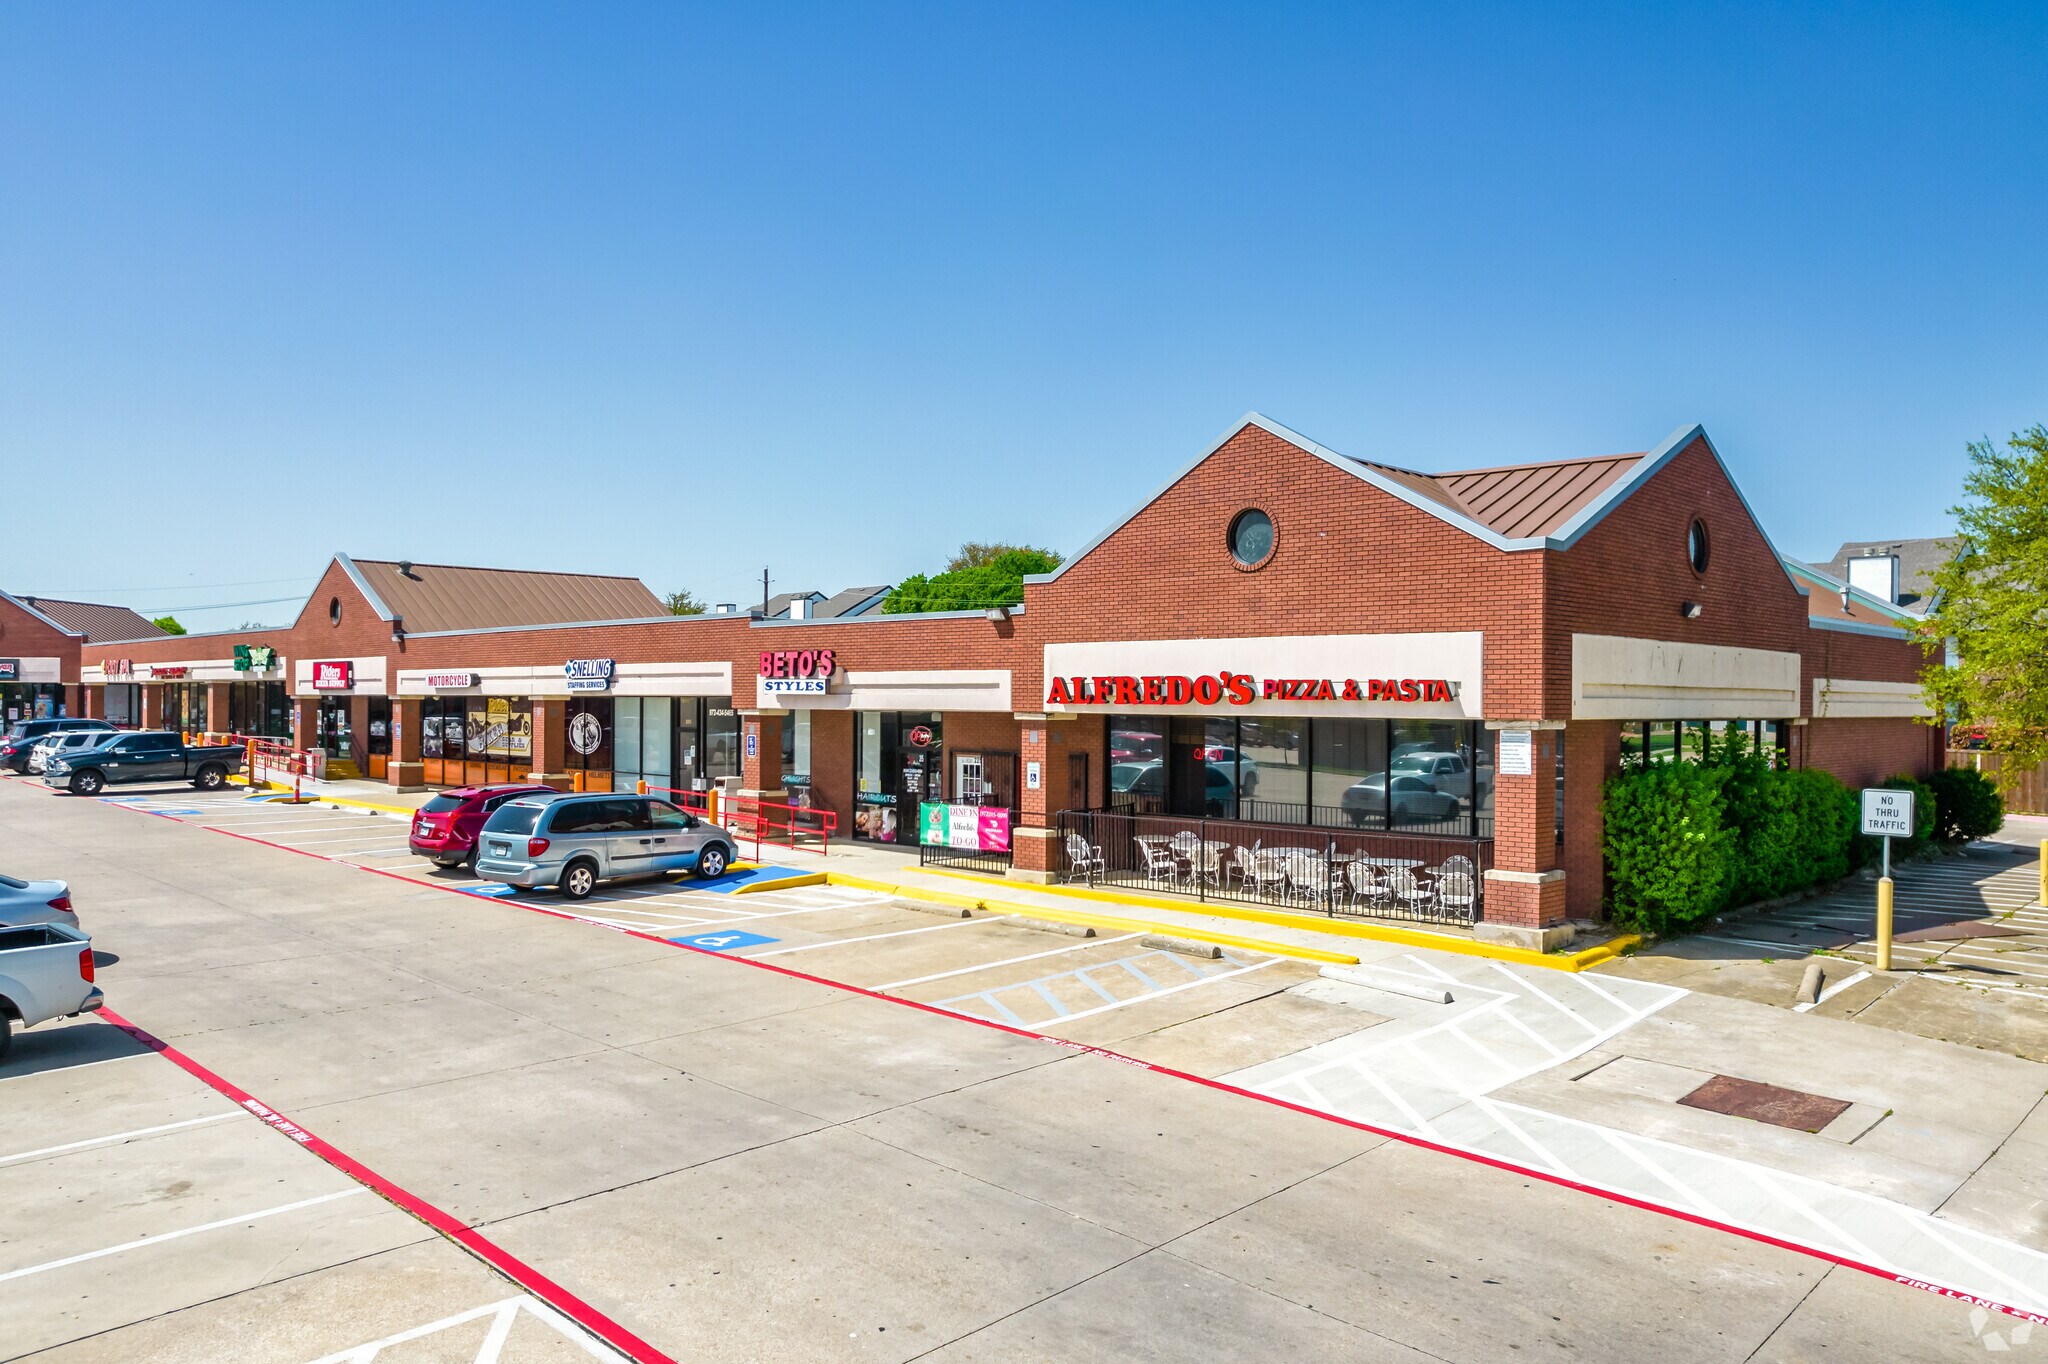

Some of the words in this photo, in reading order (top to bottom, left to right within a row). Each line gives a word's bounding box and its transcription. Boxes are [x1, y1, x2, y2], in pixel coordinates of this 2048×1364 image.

[571, 659, 611, 678] SNELLING
[760, 650, 835, 678] BETO'S
[320, 665, 341, 680] Riders
[428, 675, 468, 687] MOTORCYCLE
[567, 681, 585, 690] STAFFING
[586, 680, 605, 689] SERVICES
[765, 681, 825, 691] STYLES
[1046, 671, 1256, 706] ALFREDO'S
[1263, 679, 1338, 701] PIZZA
[1342, 679, 1363, 701] &
[1368, 679, 1455, 702] PASTA
[1193, 748, 1224, 761] OPEN
[1881, 796, 1894, 806] NO
[1876, 808, 1900, 818] THRU
[1869, 819, 1906, 831] TRAFFIC
[1895, 1276, 1942, 1294] FIRE
[1944, 1290, 2006, 1312] LANE
